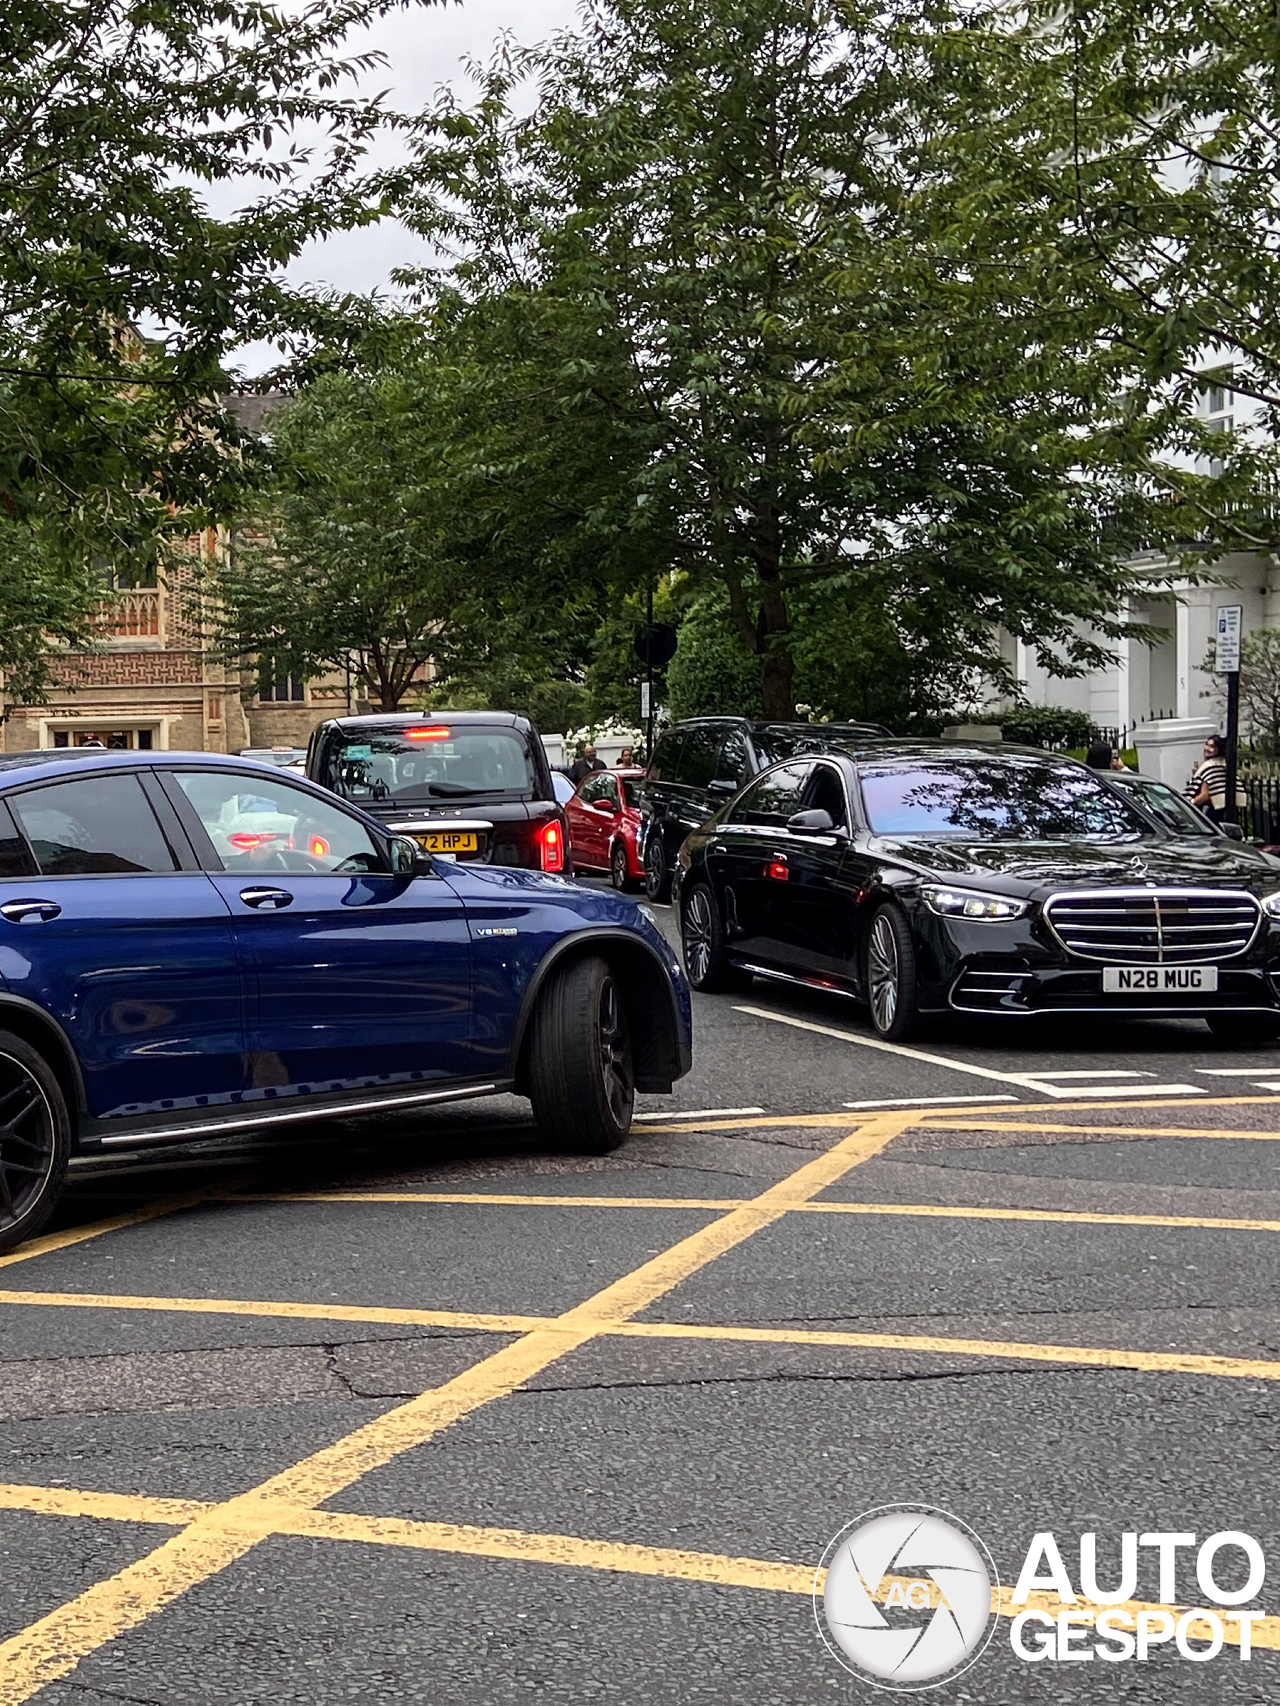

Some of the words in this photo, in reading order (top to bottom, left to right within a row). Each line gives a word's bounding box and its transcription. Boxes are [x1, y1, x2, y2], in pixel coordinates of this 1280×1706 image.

[412, 835, 439, 848] 72
[442, 834, 471, 848] HPJ
[1118, 970, 1158, 988] N28
[1164, 970, 1201, 988] MUG
